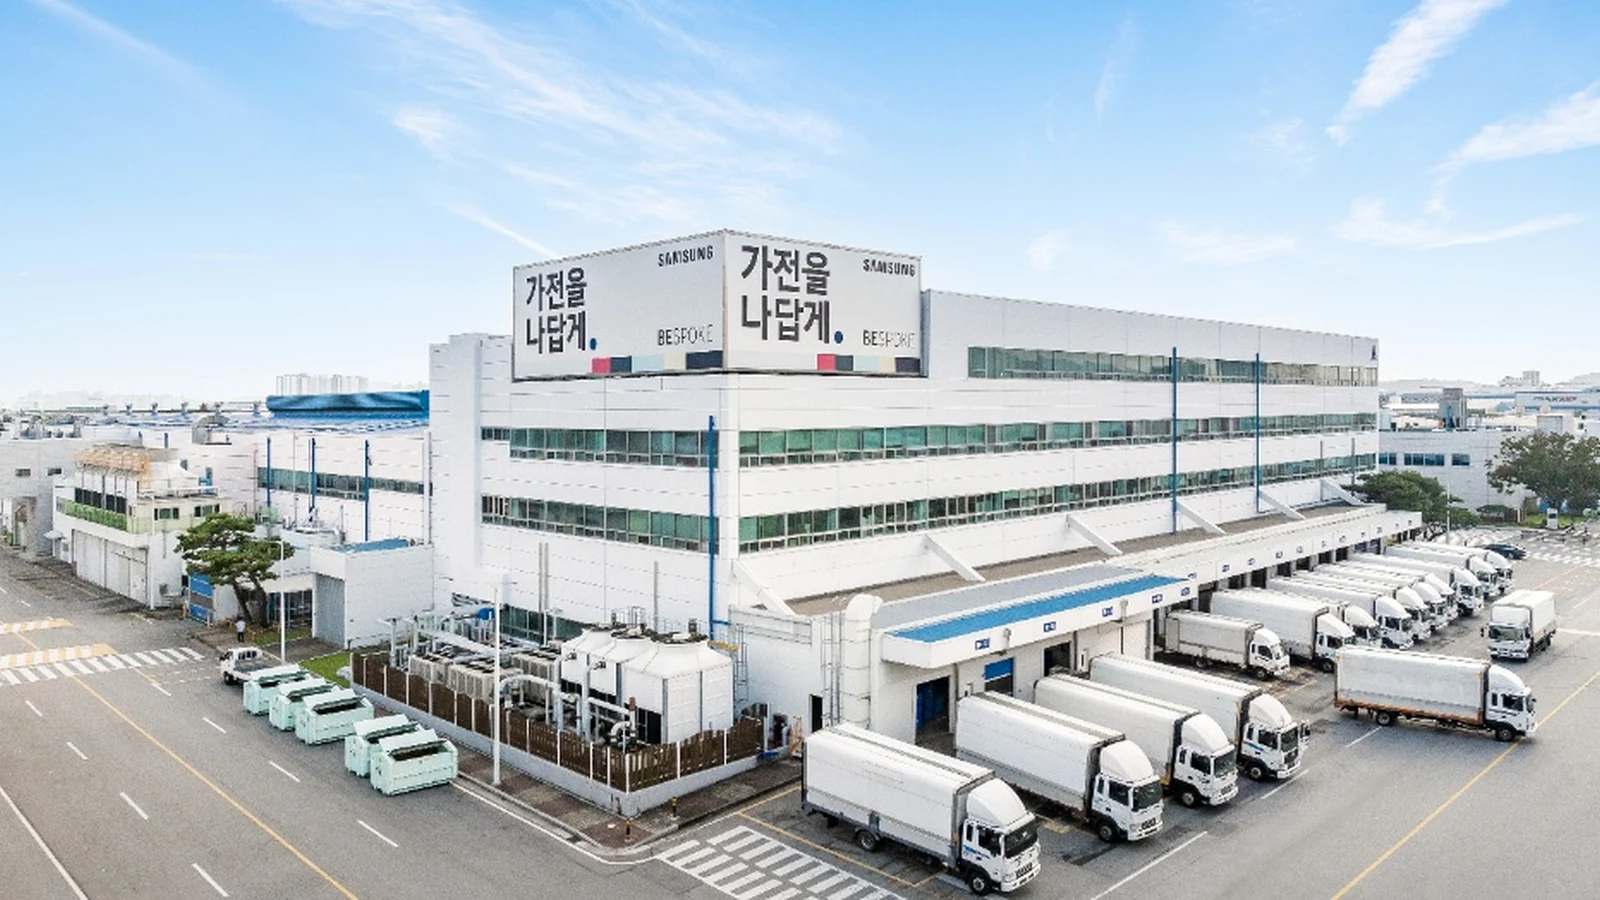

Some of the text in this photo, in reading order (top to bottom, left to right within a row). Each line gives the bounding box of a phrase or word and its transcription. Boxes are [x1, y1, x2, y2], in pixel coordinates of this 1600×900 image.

[658, 244, 714, 267] SAMSUNG
[741, 245, 830, 296] 가전을
[863, 259, 916, 277] SAMSUNG
[526, 267, 587, 312] 가전을
[657, 323, 713, 346] BESPOKE
[863, 329, 916, 349] BESPOKE
